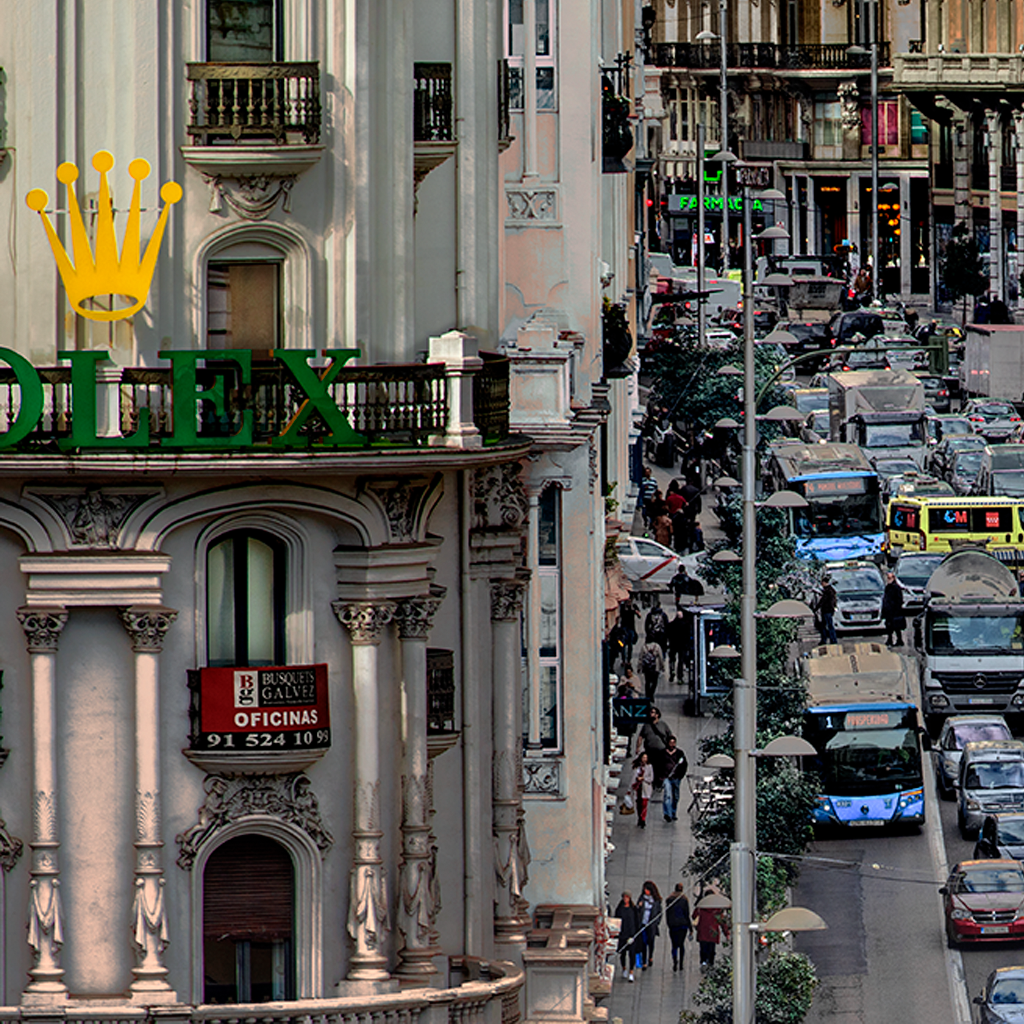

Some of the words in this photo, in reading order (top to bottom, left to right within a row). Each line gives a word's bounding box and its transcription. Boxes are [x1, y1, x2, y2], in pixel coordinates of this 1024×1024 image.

[680, 196, 763, 211] FARMACA
[262, 671, 315, 687] BUSQUETS
[262, 685, 315, 699] GALVEZ
[234, 709, 318, 727] OFICINAS
[825, 716, 833, 729] 1
[207, 733, 235, 748] 91
[245, 733, 286, 747] 524
[294, 731, 313, 746] 10
